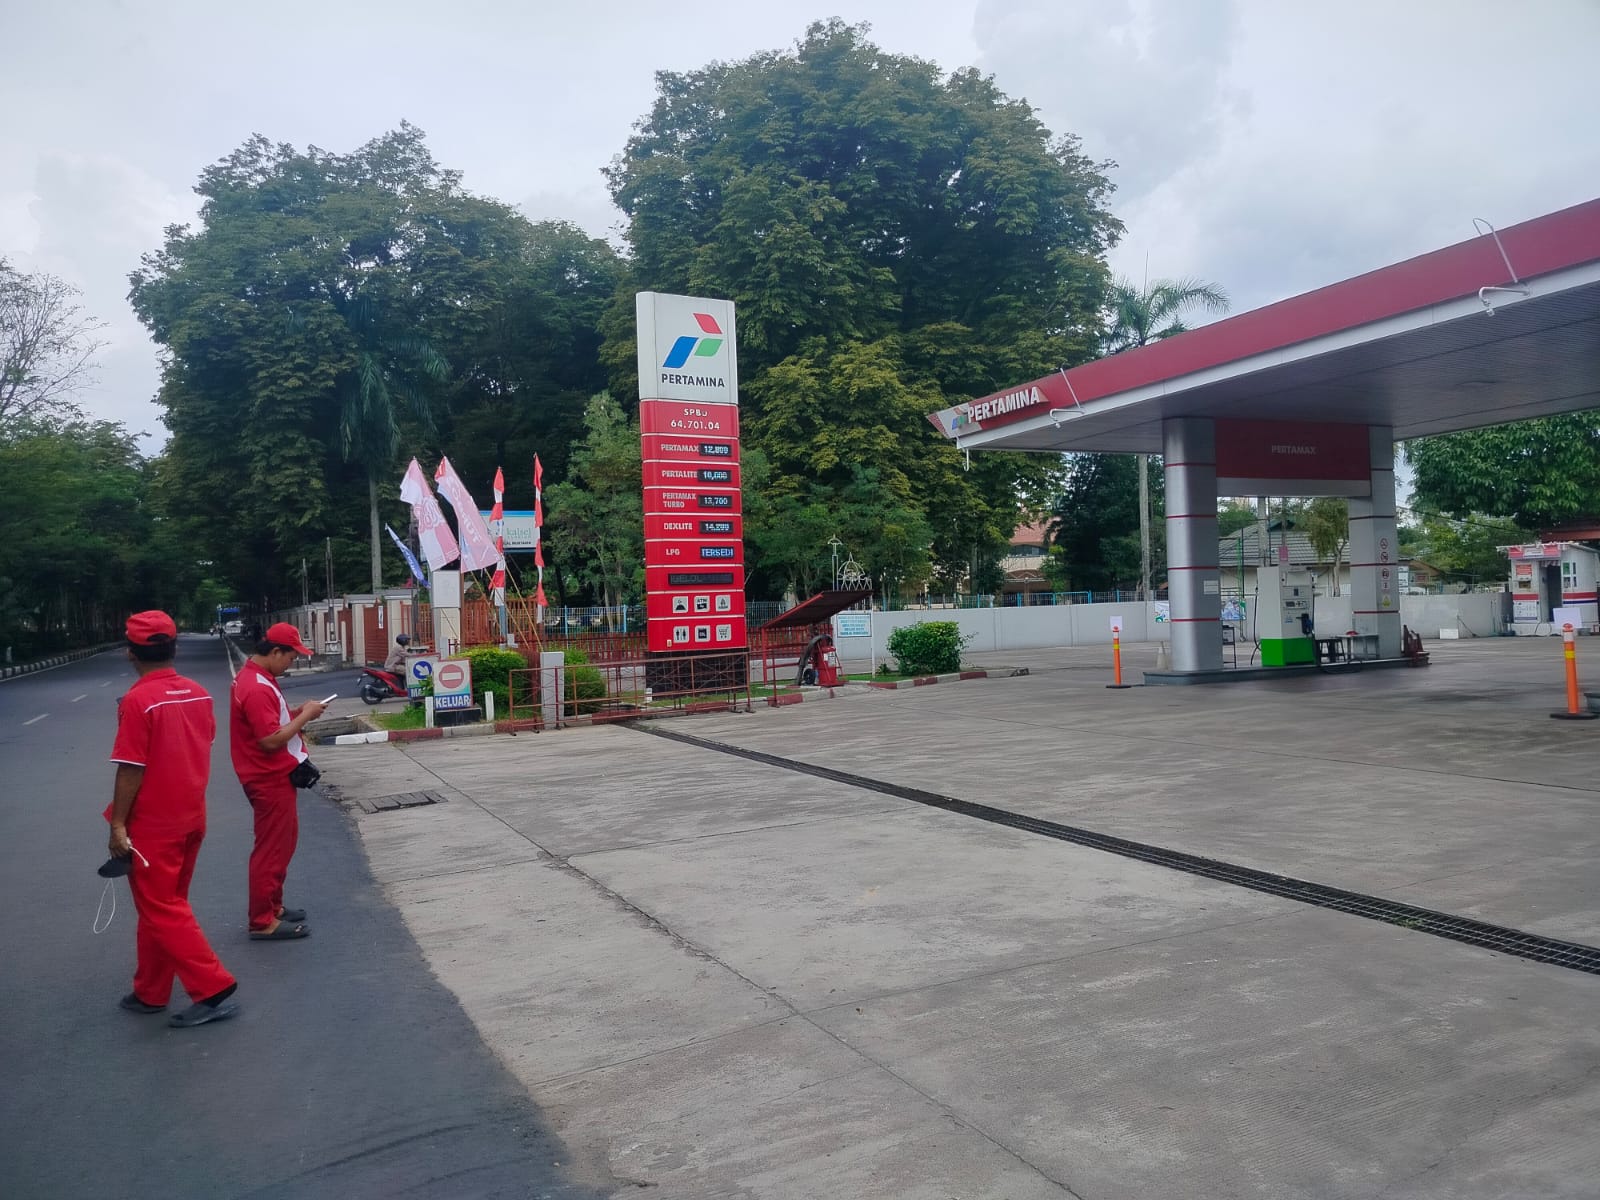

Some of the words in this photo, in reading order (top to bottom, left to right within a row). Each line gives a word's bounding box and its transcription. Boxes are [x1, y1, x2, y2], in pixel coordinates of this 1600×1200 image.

[661, 373, 725, 388] PERTAMINA
[967, 386, 1041, 424] PERTAMINA
[670, 419, 721, 430] 64.701.04
[660, 443, 700, 453] PERTAMAX
[661, 470, 698, 479] PERTALITE
[662, 492, 697, 500] PERTAMAX
[663, 522, 693, 530] DEXLITE
[665, 548, 681, 556] LPG
[435, 695, 471, 709] KELUAR
